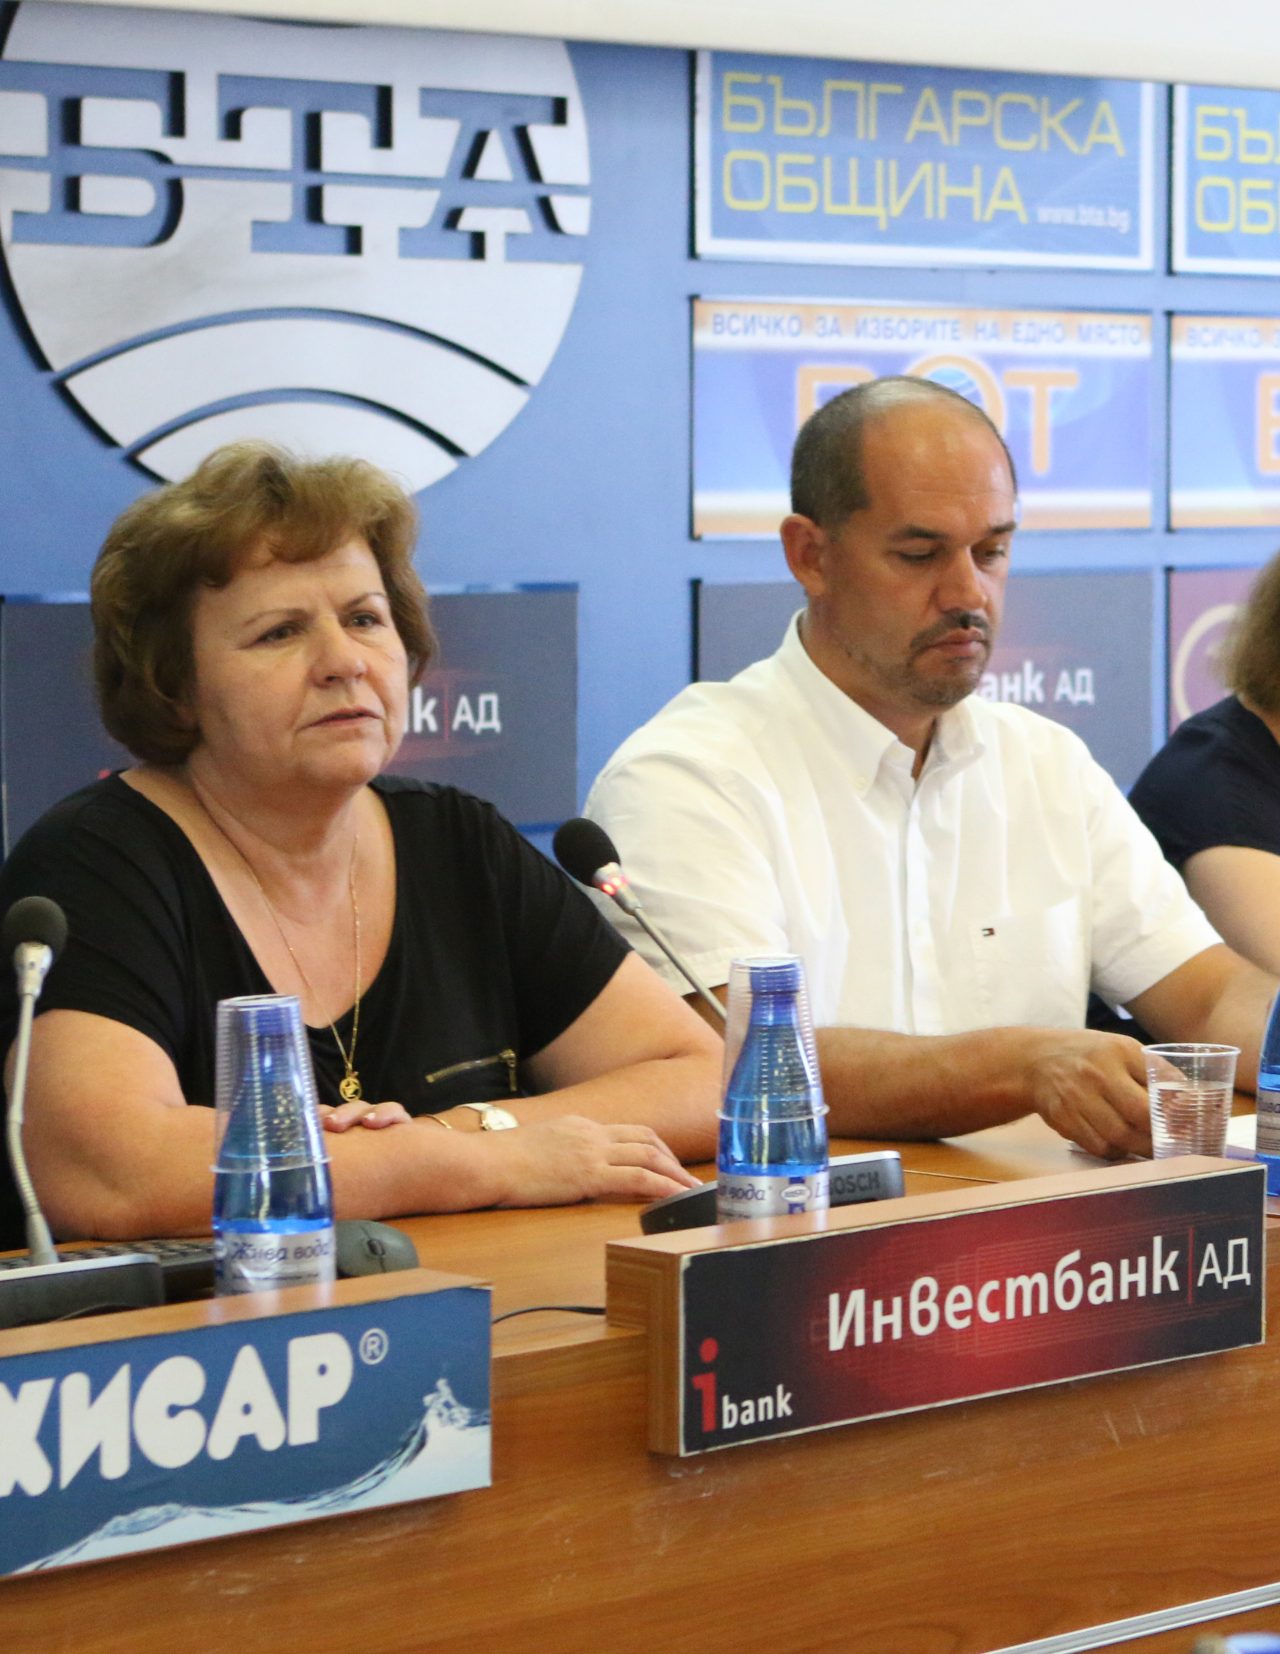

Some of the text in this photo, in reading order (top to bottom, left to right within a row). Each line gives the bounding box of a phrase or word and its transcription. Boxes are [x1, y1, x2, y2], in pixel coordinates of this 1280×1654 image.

[722, 70, 1126, 157] БЪЛГАРСКА
[0, 60, 590, 262] БТА
[722, 149, 1028, 231] ОБЩИНА
[713, 313, 1142, 346] ВСИЧКО ЗА ИЗБОРИТЕ НА ЕДНО МЯСТО
[452, 692, 502, 736] АД
[1054, 667, 1096, 706] АД
[829, 1171, 881, 1197] OSCH
[827, 1236, 1252, 1352] Инвестбанк АД
